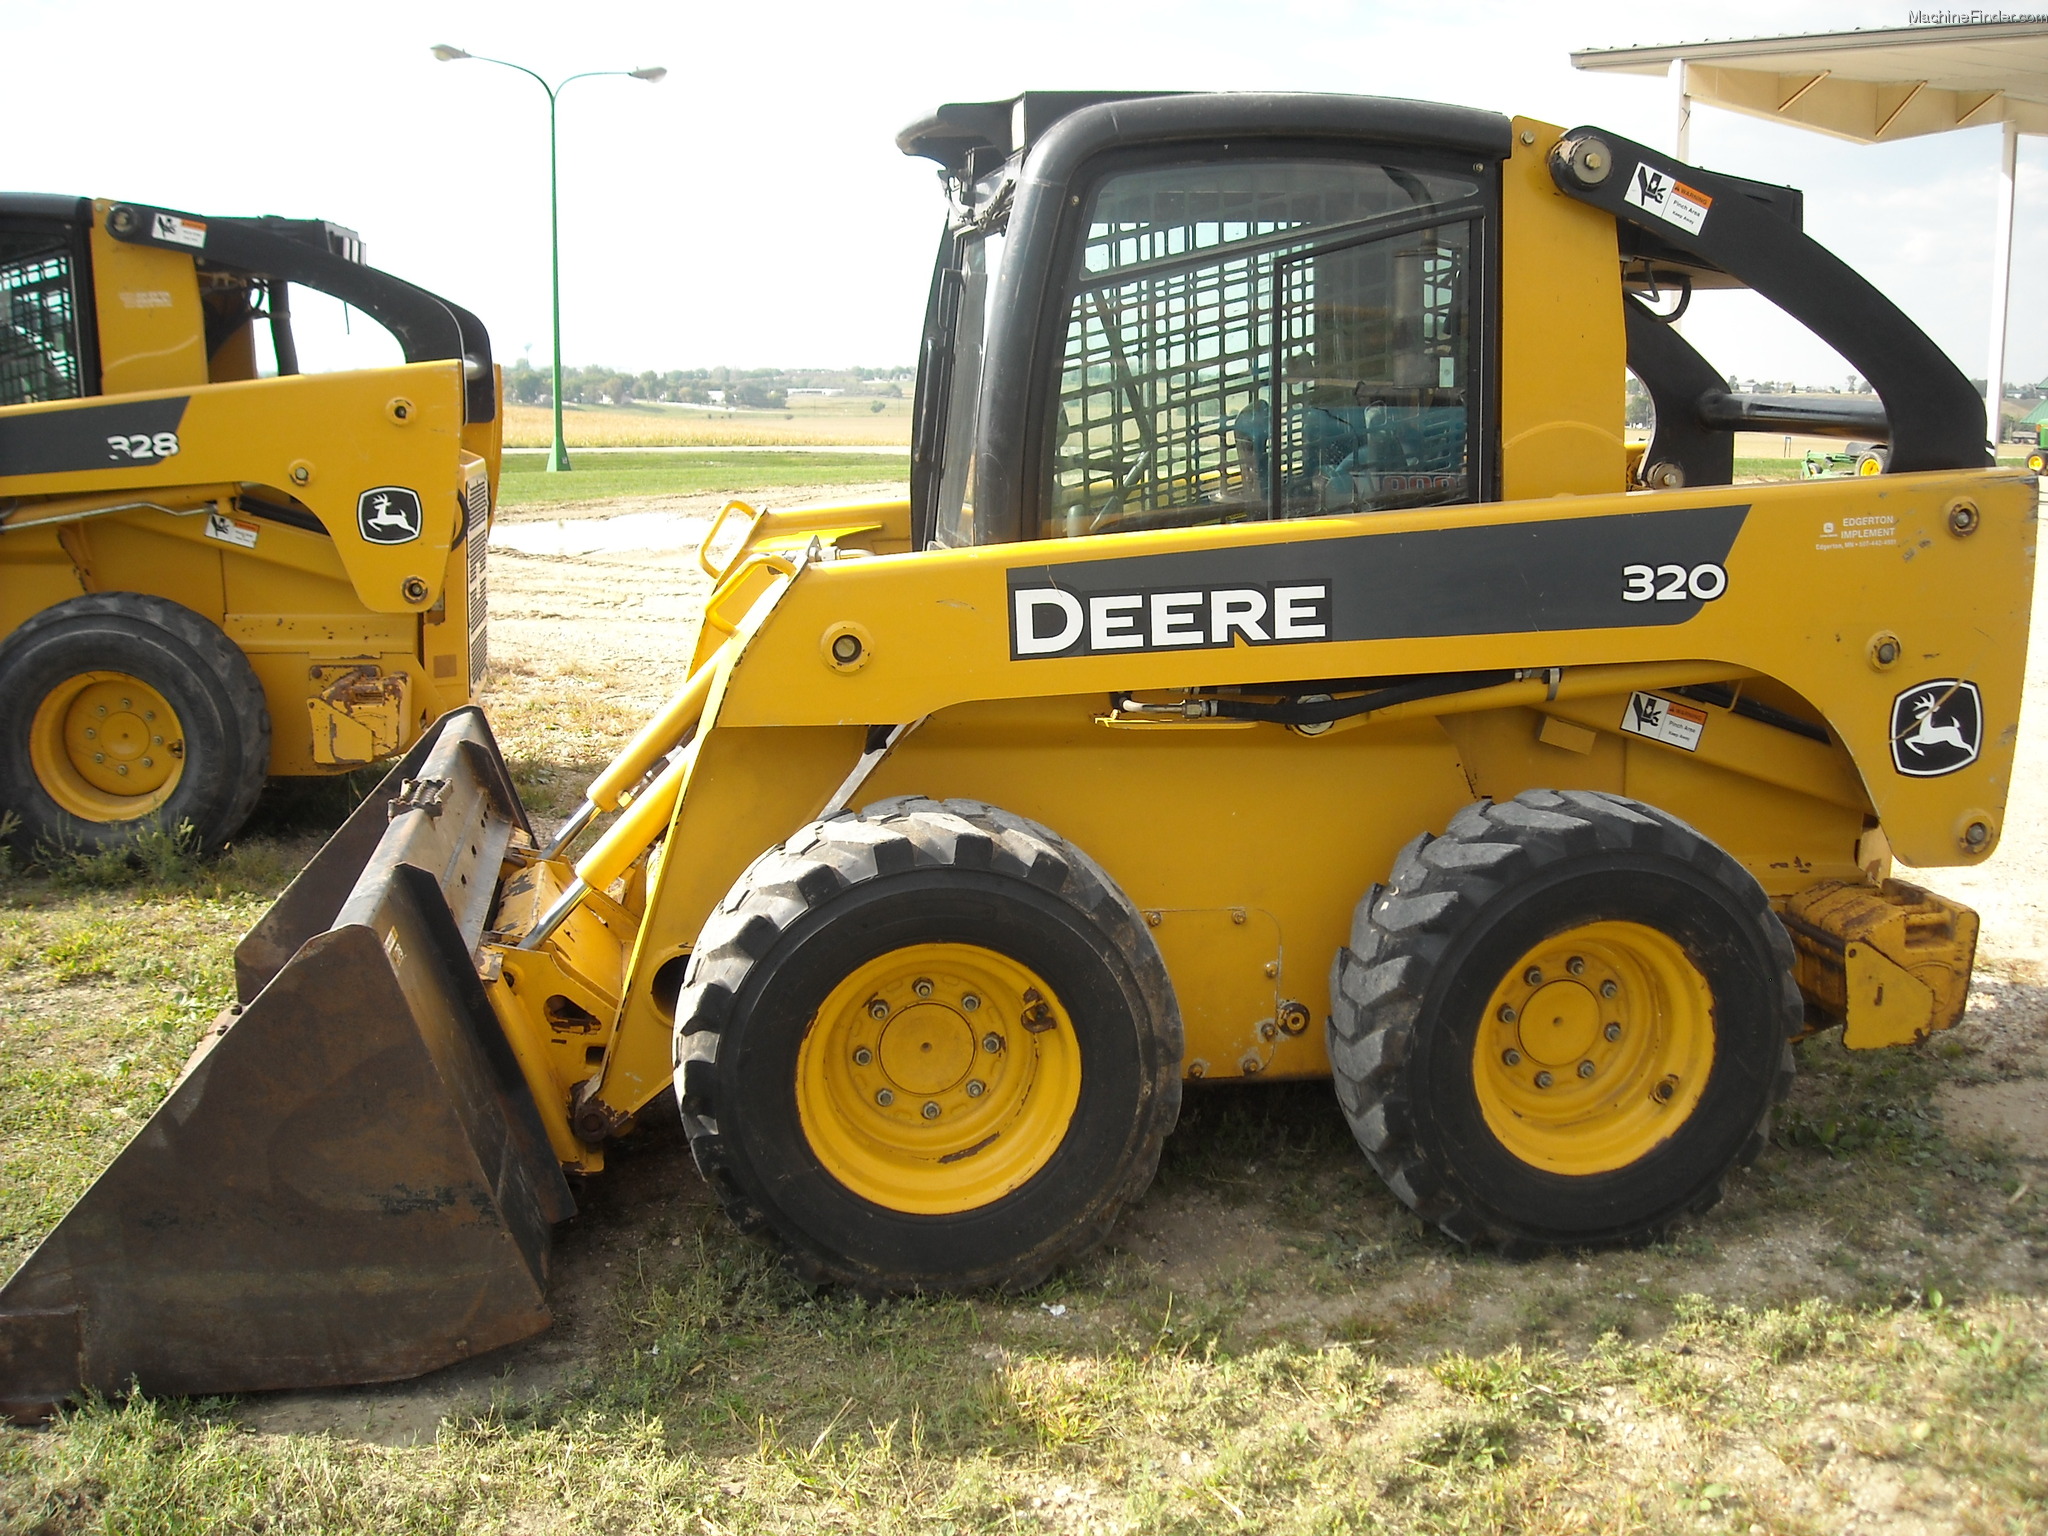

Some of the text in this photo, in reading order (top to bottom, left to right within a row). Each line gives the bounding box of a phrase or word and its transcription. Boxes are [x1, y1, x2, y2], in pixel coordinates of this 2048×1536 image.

[1681, 188, 1707, 205] WARNING
[1673, 200, 1700, 217] Pinch Area
[107, 432, 179, 460] 328
[1842, 515, 1894, 527] EDGERTON
[1841, 527, 1895, 539] IMPLEMENT
[1623, 563, 1726, 602] 320
[1014, 585, 1326, 654] DEERE
[1669, 721, 1696, 733] Pinch Area
